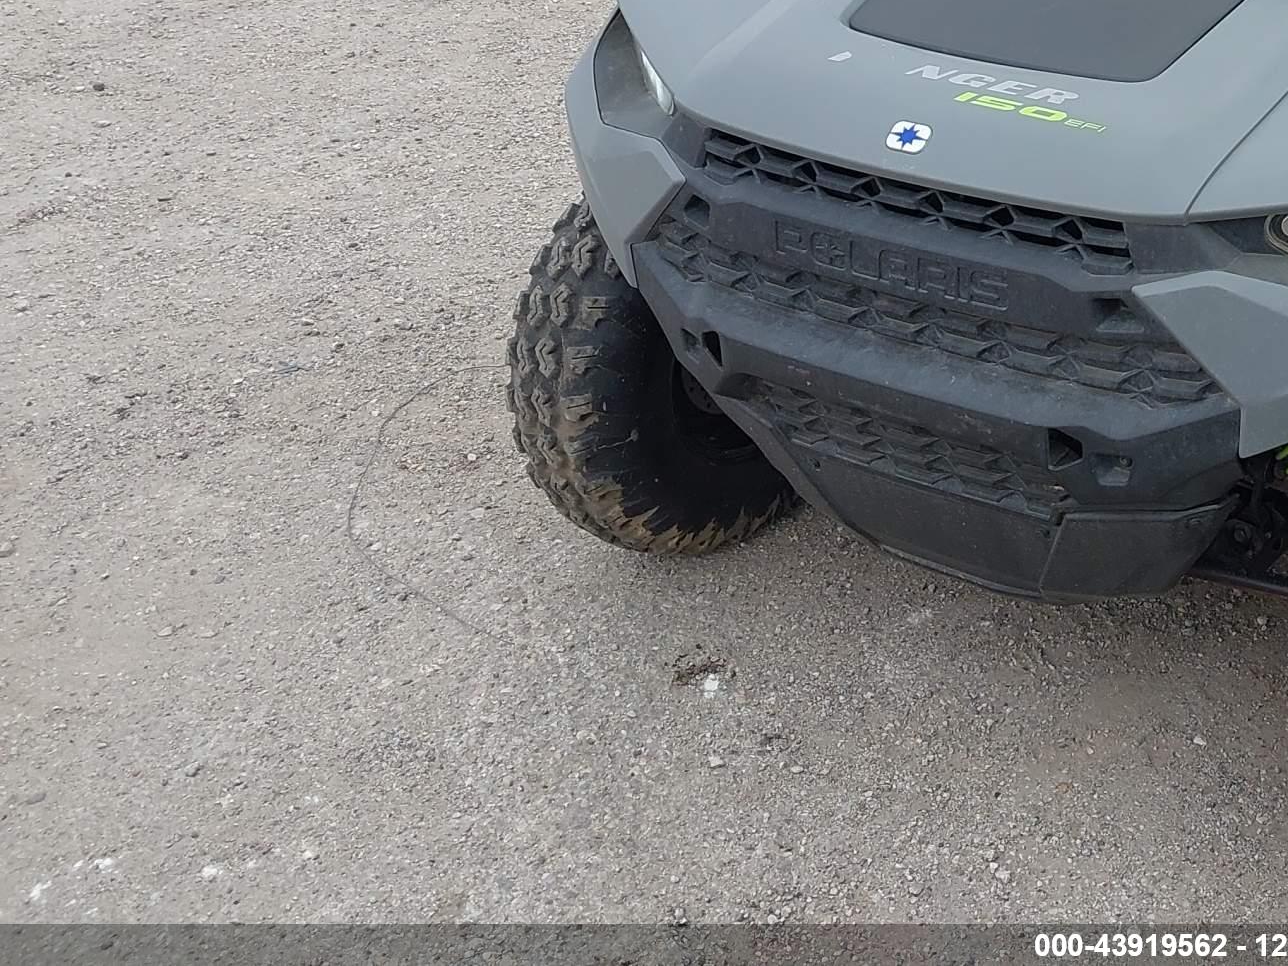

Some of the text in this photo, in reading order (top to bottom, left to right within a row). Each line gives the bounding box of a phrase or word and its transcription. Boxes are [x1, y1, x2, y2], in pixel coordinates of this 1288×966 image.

[953, 92, 1107, 135] 150 EFI
[774, 219, 1009, 311] POLARIS
